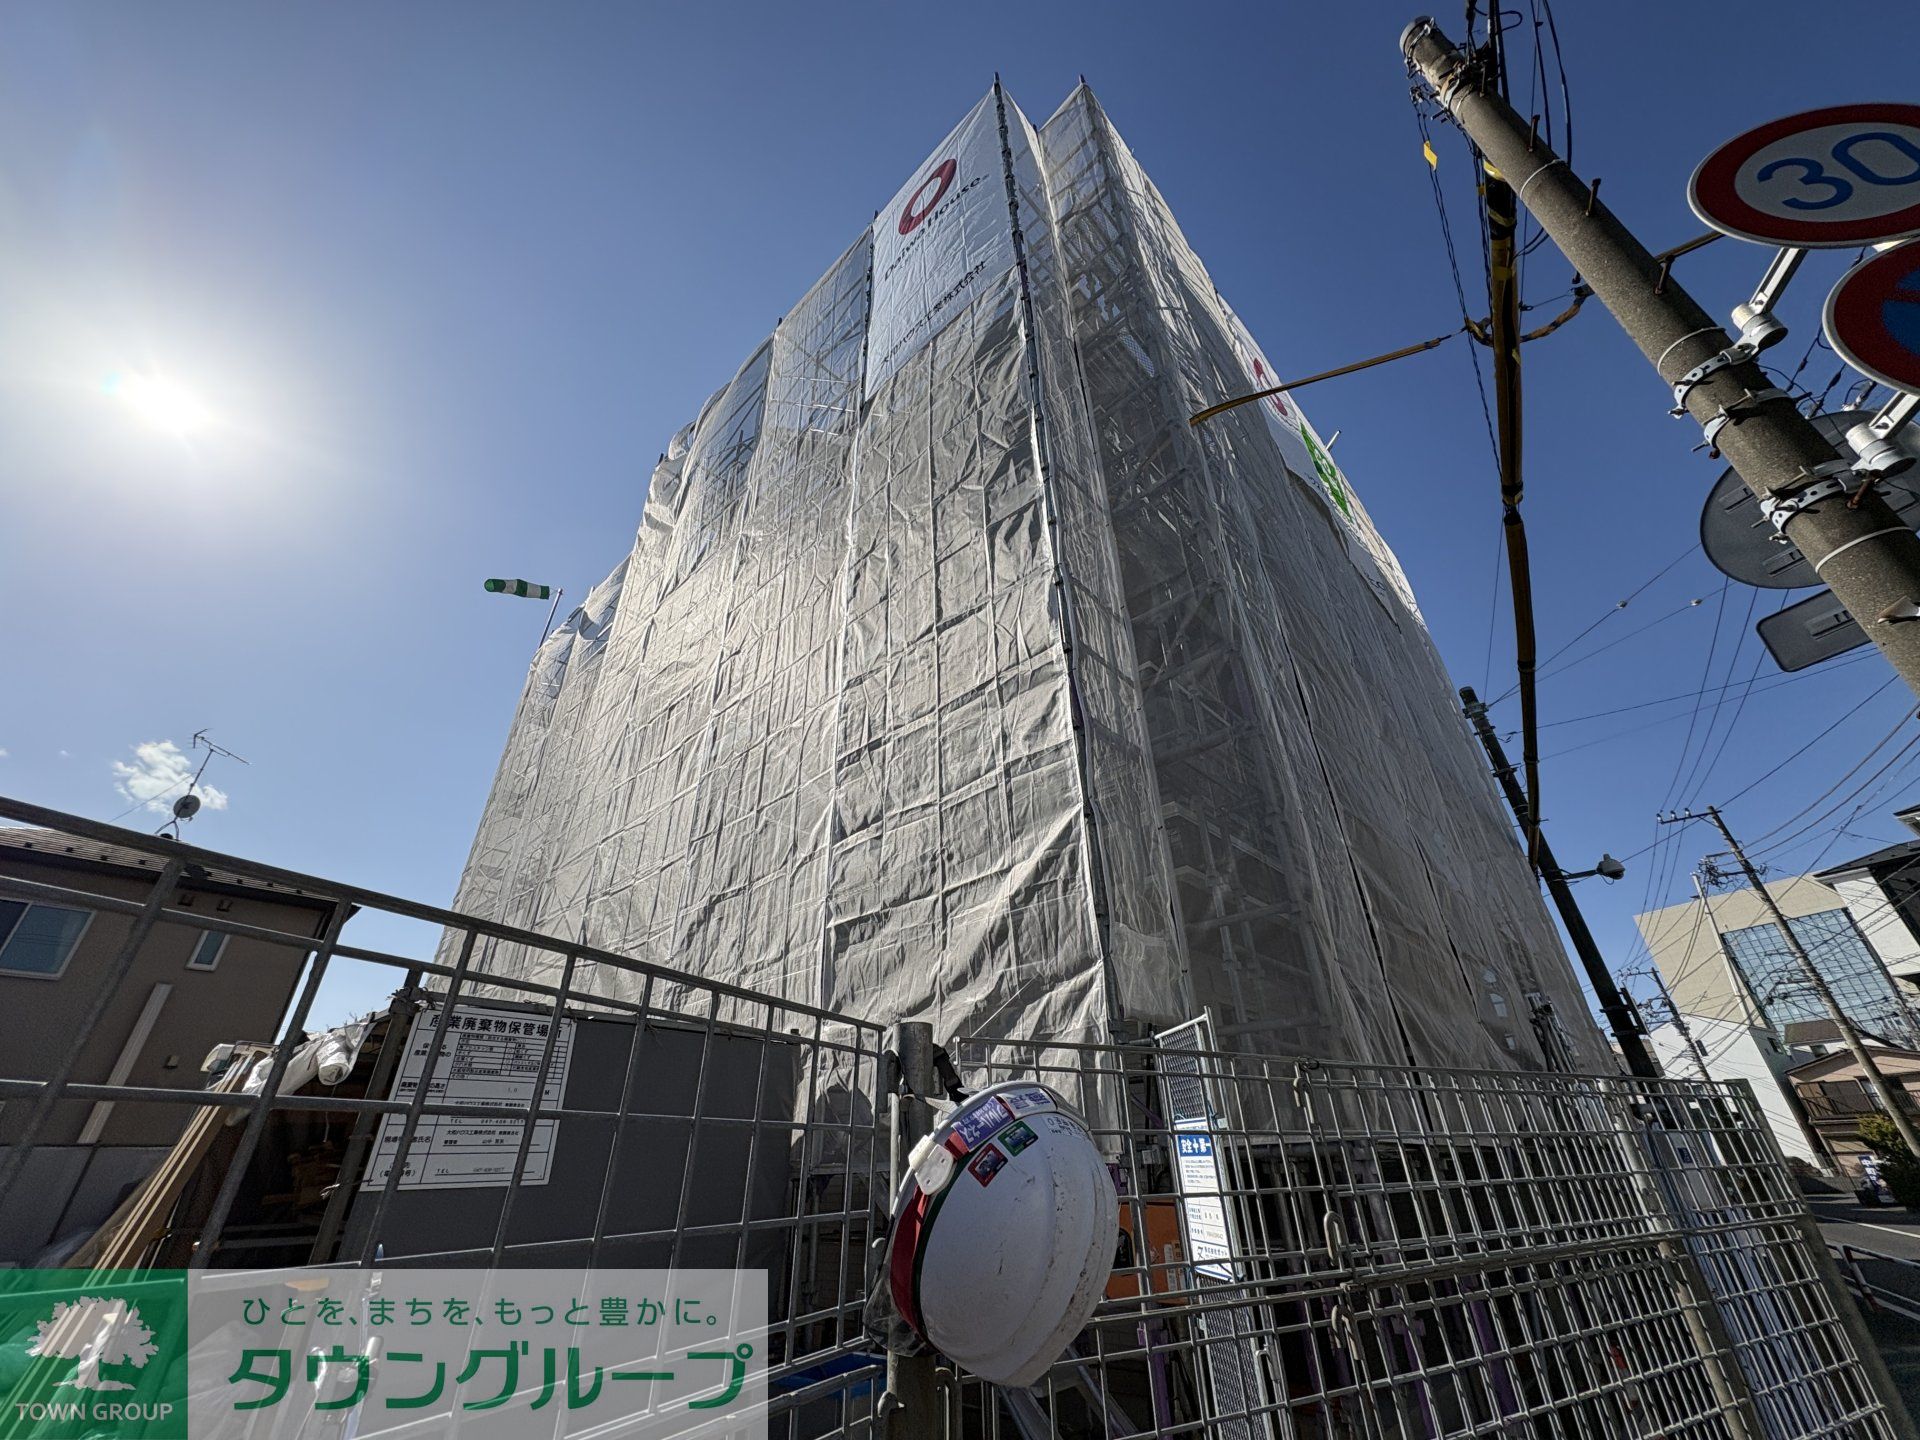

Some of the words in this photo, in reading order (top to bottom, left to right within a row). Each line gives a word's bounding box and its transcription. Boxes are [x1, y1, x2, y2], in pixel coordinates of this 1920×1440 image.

[1757, 132, 1920, 210] 30
[884, 227, 926, 282] Daiwa
[927, 177, 982, 229] House
[429, 1014, 562, 1039] 産業廃棄物保管場
